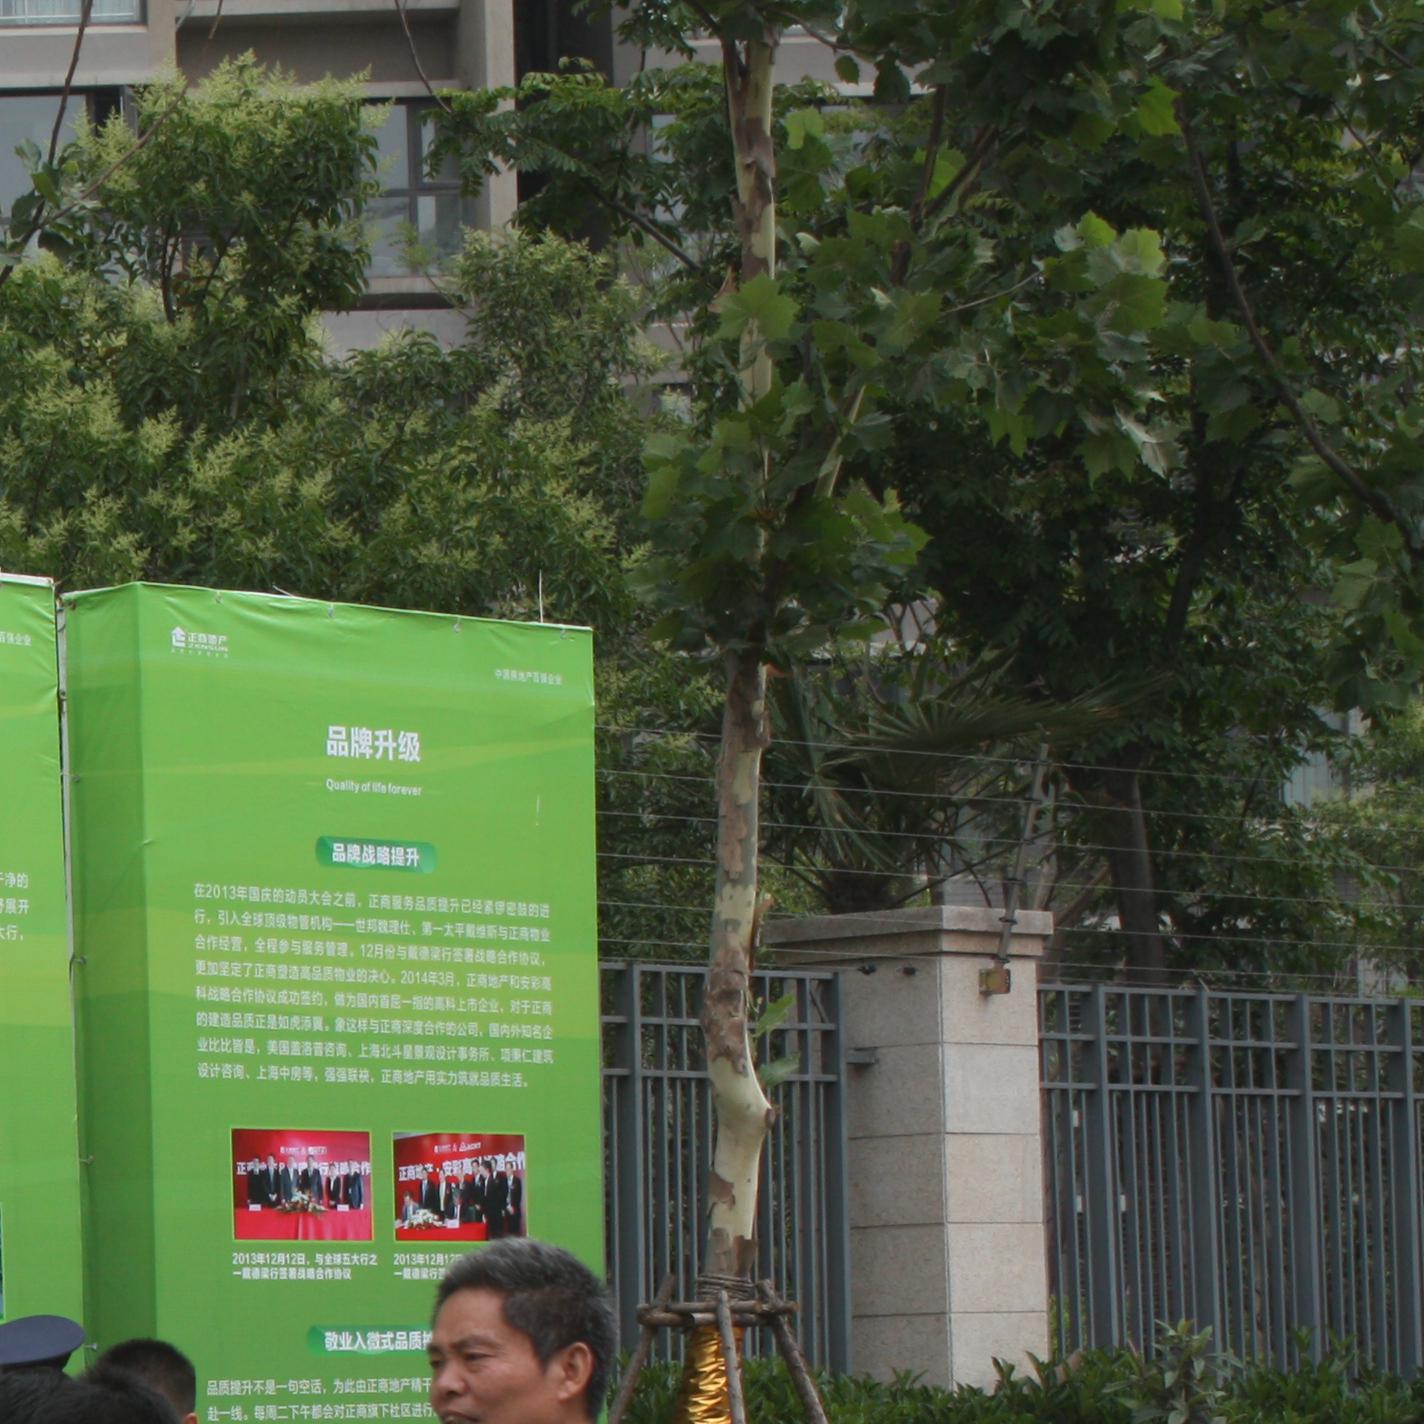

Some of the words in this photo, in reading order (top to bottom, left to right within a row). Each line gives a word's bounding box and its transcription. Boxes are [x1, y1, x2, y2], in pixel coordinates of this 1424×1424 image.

[325, 725, 421, 763] 品牌升级
[325, 777, 359, 793] Quality
[360, 780, 370, 792] of
[371, 780, 386, 793] life
[387, 782, 423, 796] forever
[331, 842, 420, 867] 品牌战略提升
[207, 1402, 438, 1422] 赴一线。每周二下午都会对正商旗下社区进行
